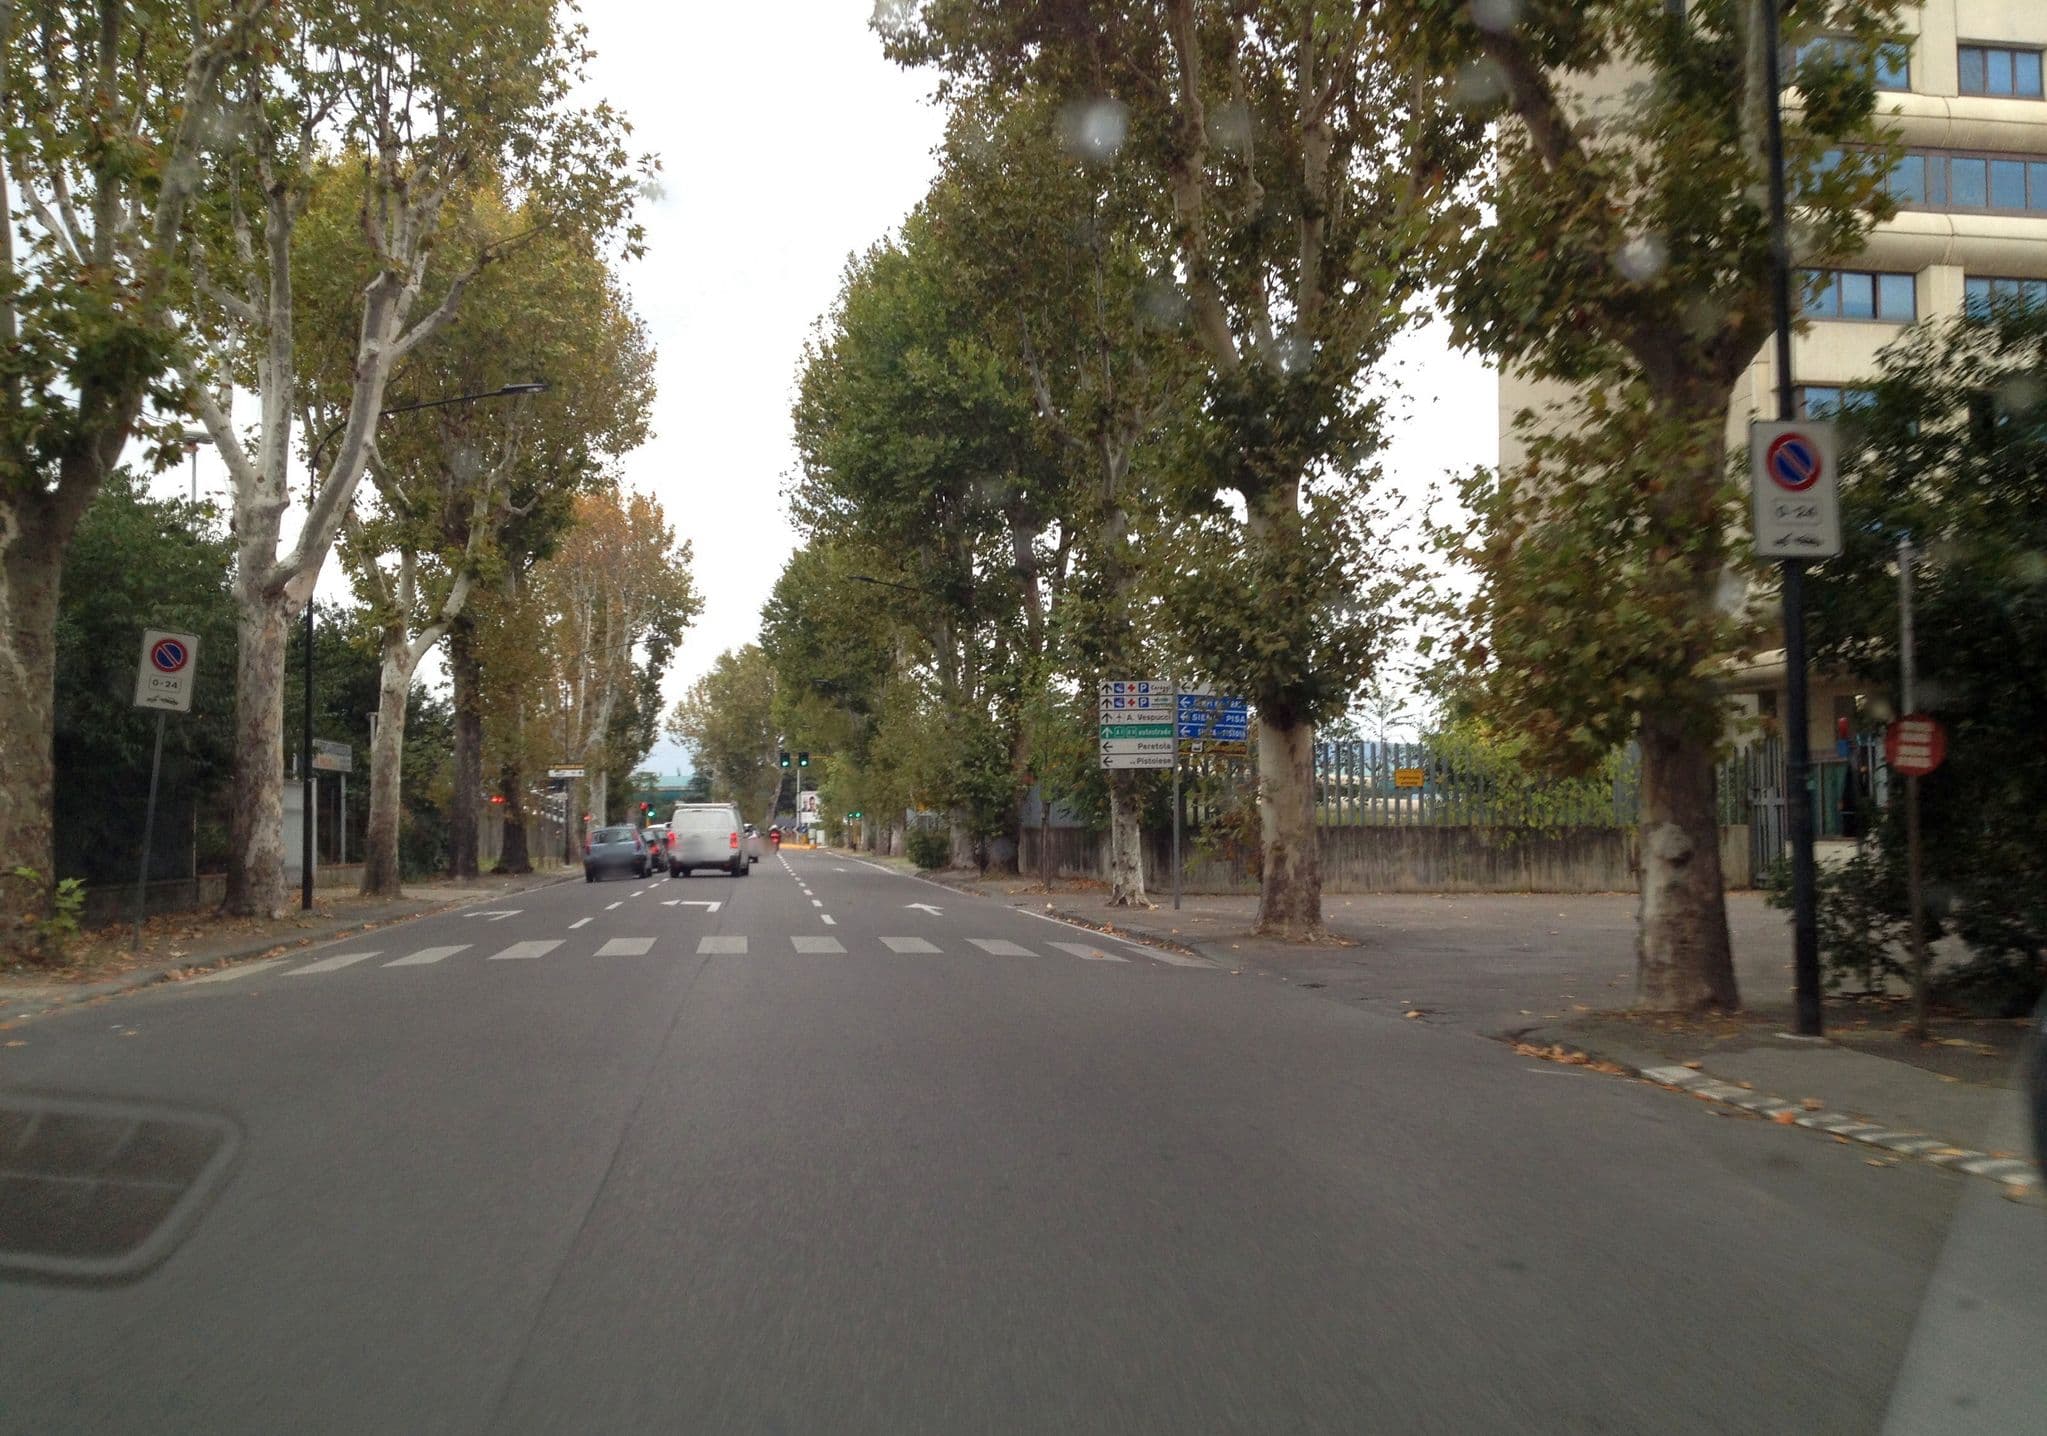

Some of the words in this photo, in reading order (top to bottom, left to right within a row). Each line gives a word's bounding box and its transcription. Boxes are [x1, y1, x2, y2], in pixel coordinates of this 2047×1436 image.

[1137, 714, 1171, 722] Vespucci
[1225, 714, 1246, 724] PISA
[1137, 742, 1172, 751] Peretola
